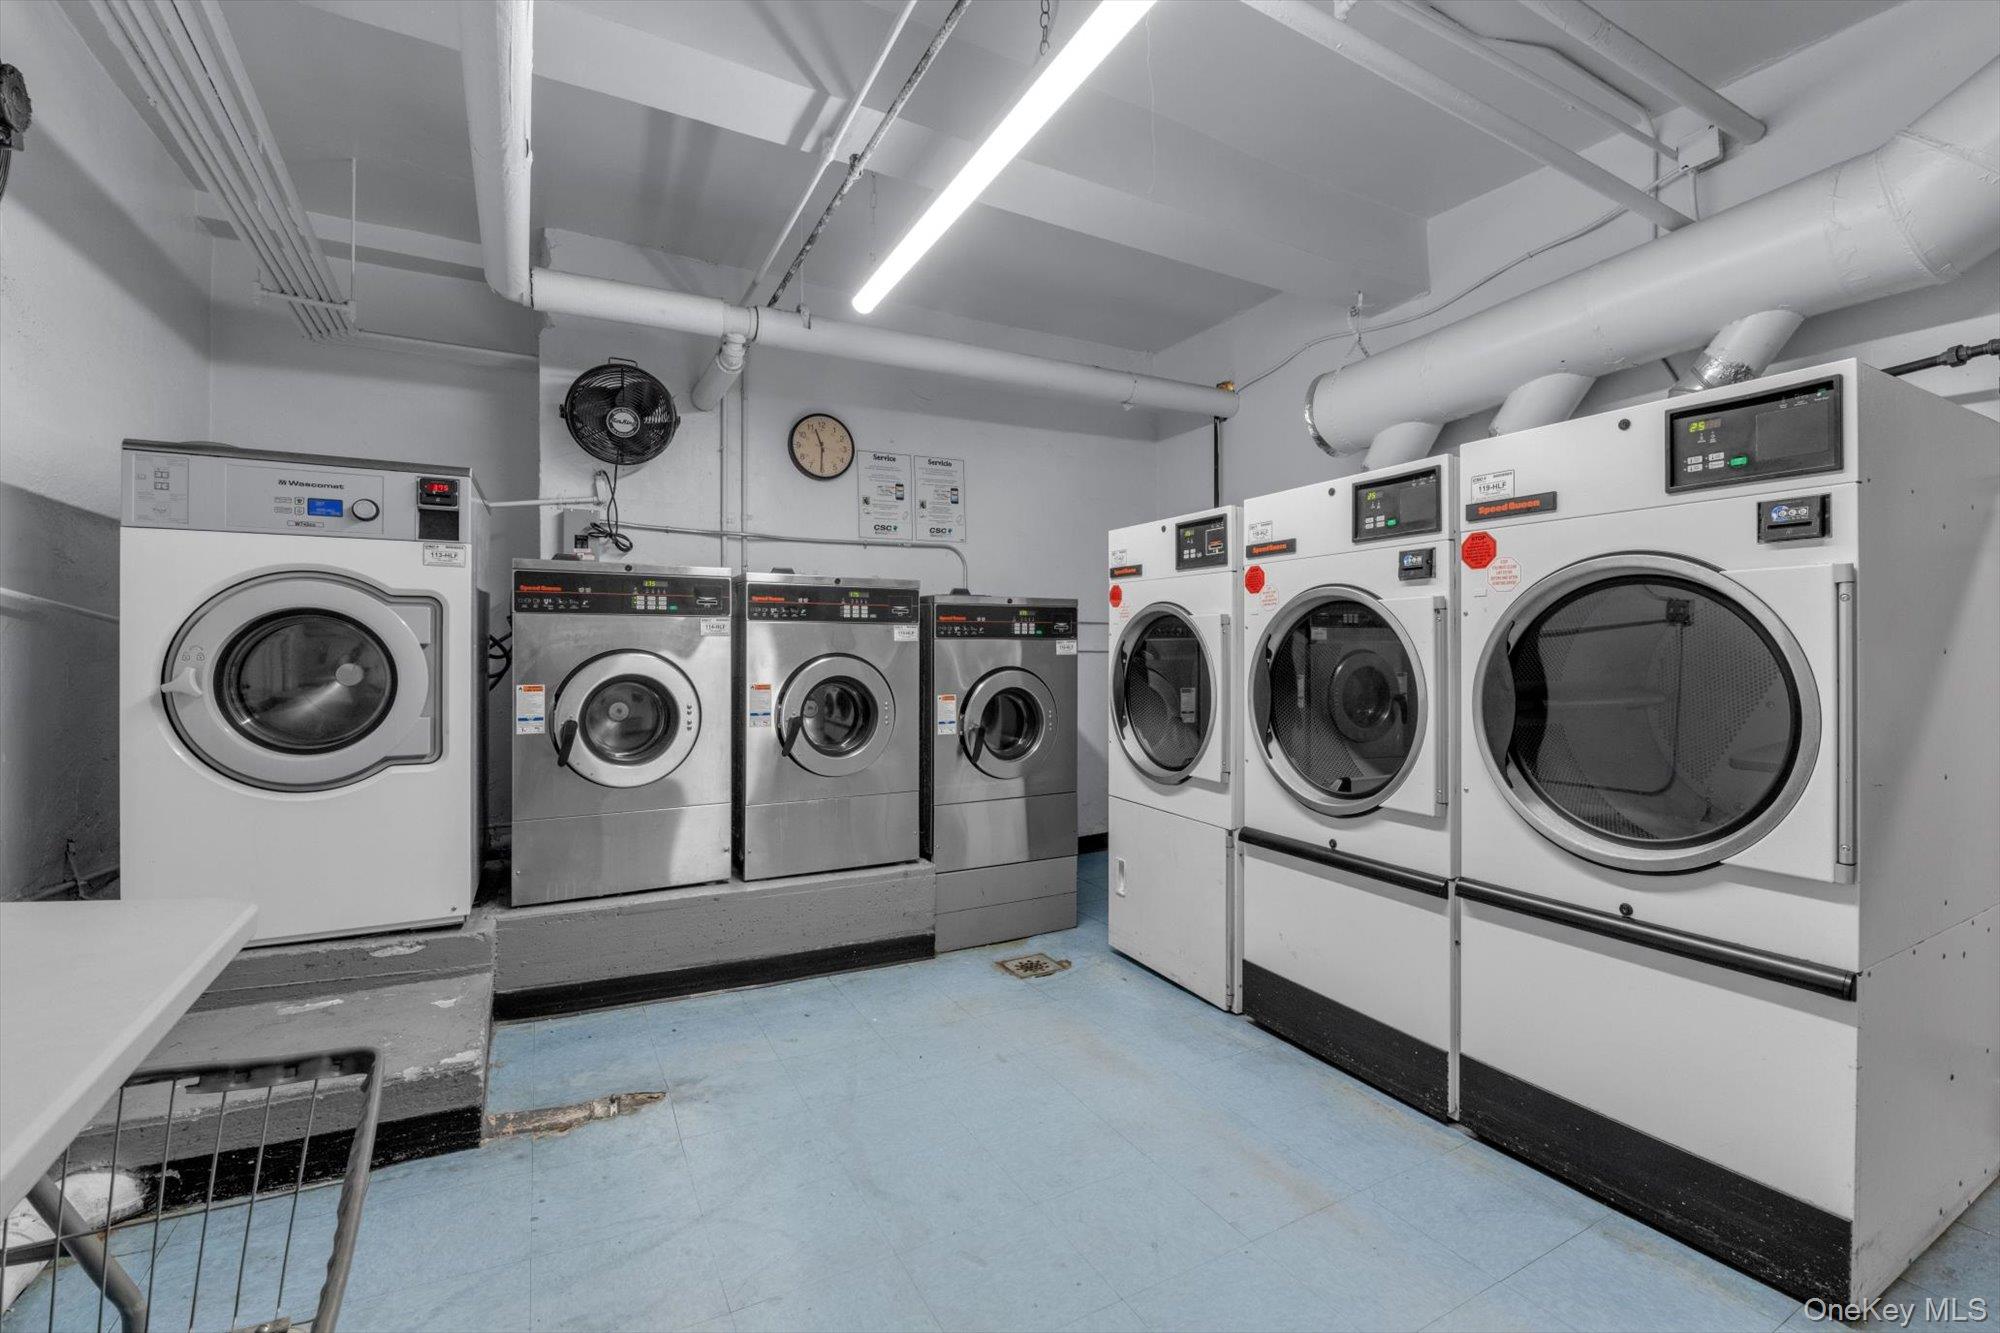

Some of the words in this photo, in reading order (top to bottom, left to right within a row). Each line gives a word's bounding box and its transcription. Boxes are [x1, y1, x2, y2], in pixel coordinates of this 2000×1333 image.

[818, 421, 826, 429] 12
[1690, 421, 1704, 432] 25
[873, 453, 896, 462] Service
[928, 459, 952, 467] Servicio
[288, 480, 344, 490] Wascomat
[1478, 504, 1508, 515] Speed
[1508, 500, 1540, 510] Queen
